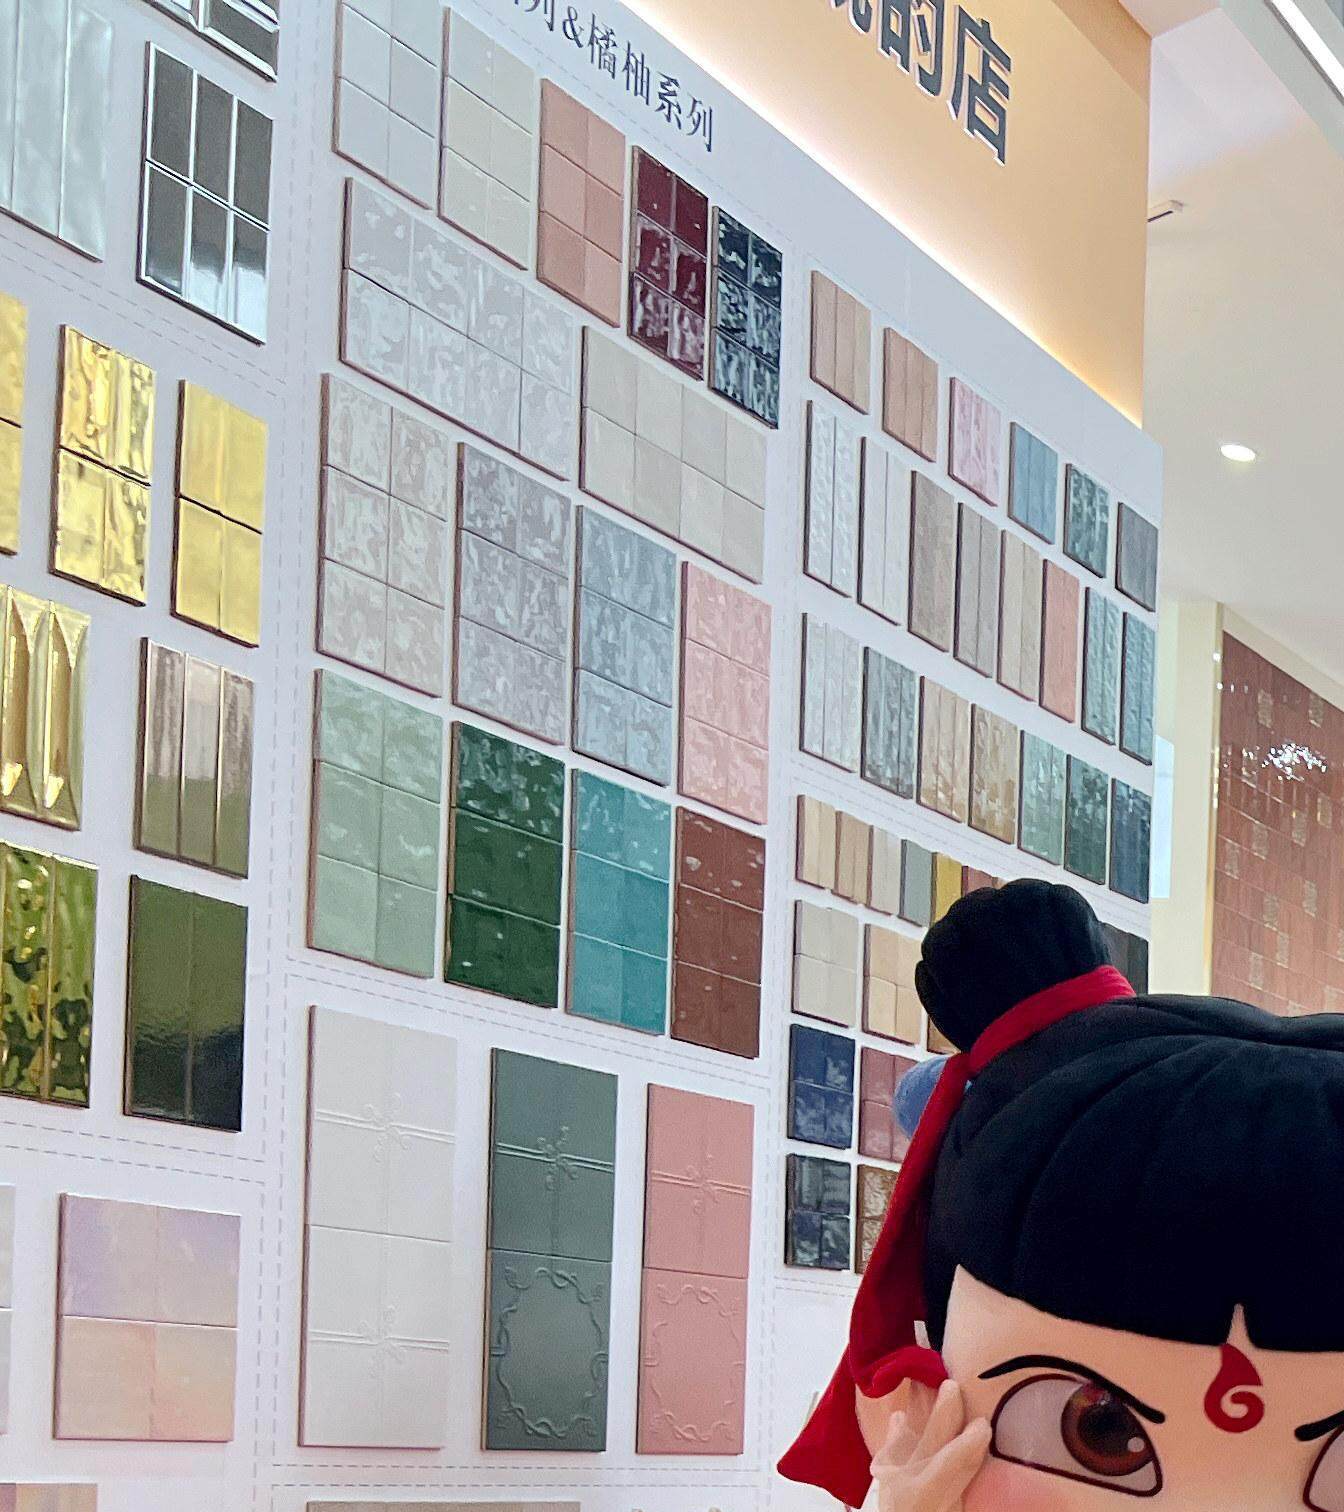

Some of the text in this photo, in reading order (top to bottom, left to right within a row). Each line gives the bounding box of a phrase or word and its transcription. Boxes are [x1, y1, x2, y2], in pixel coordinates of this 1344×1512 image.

[514, 0, 712, 153] 列&橘柚系列
